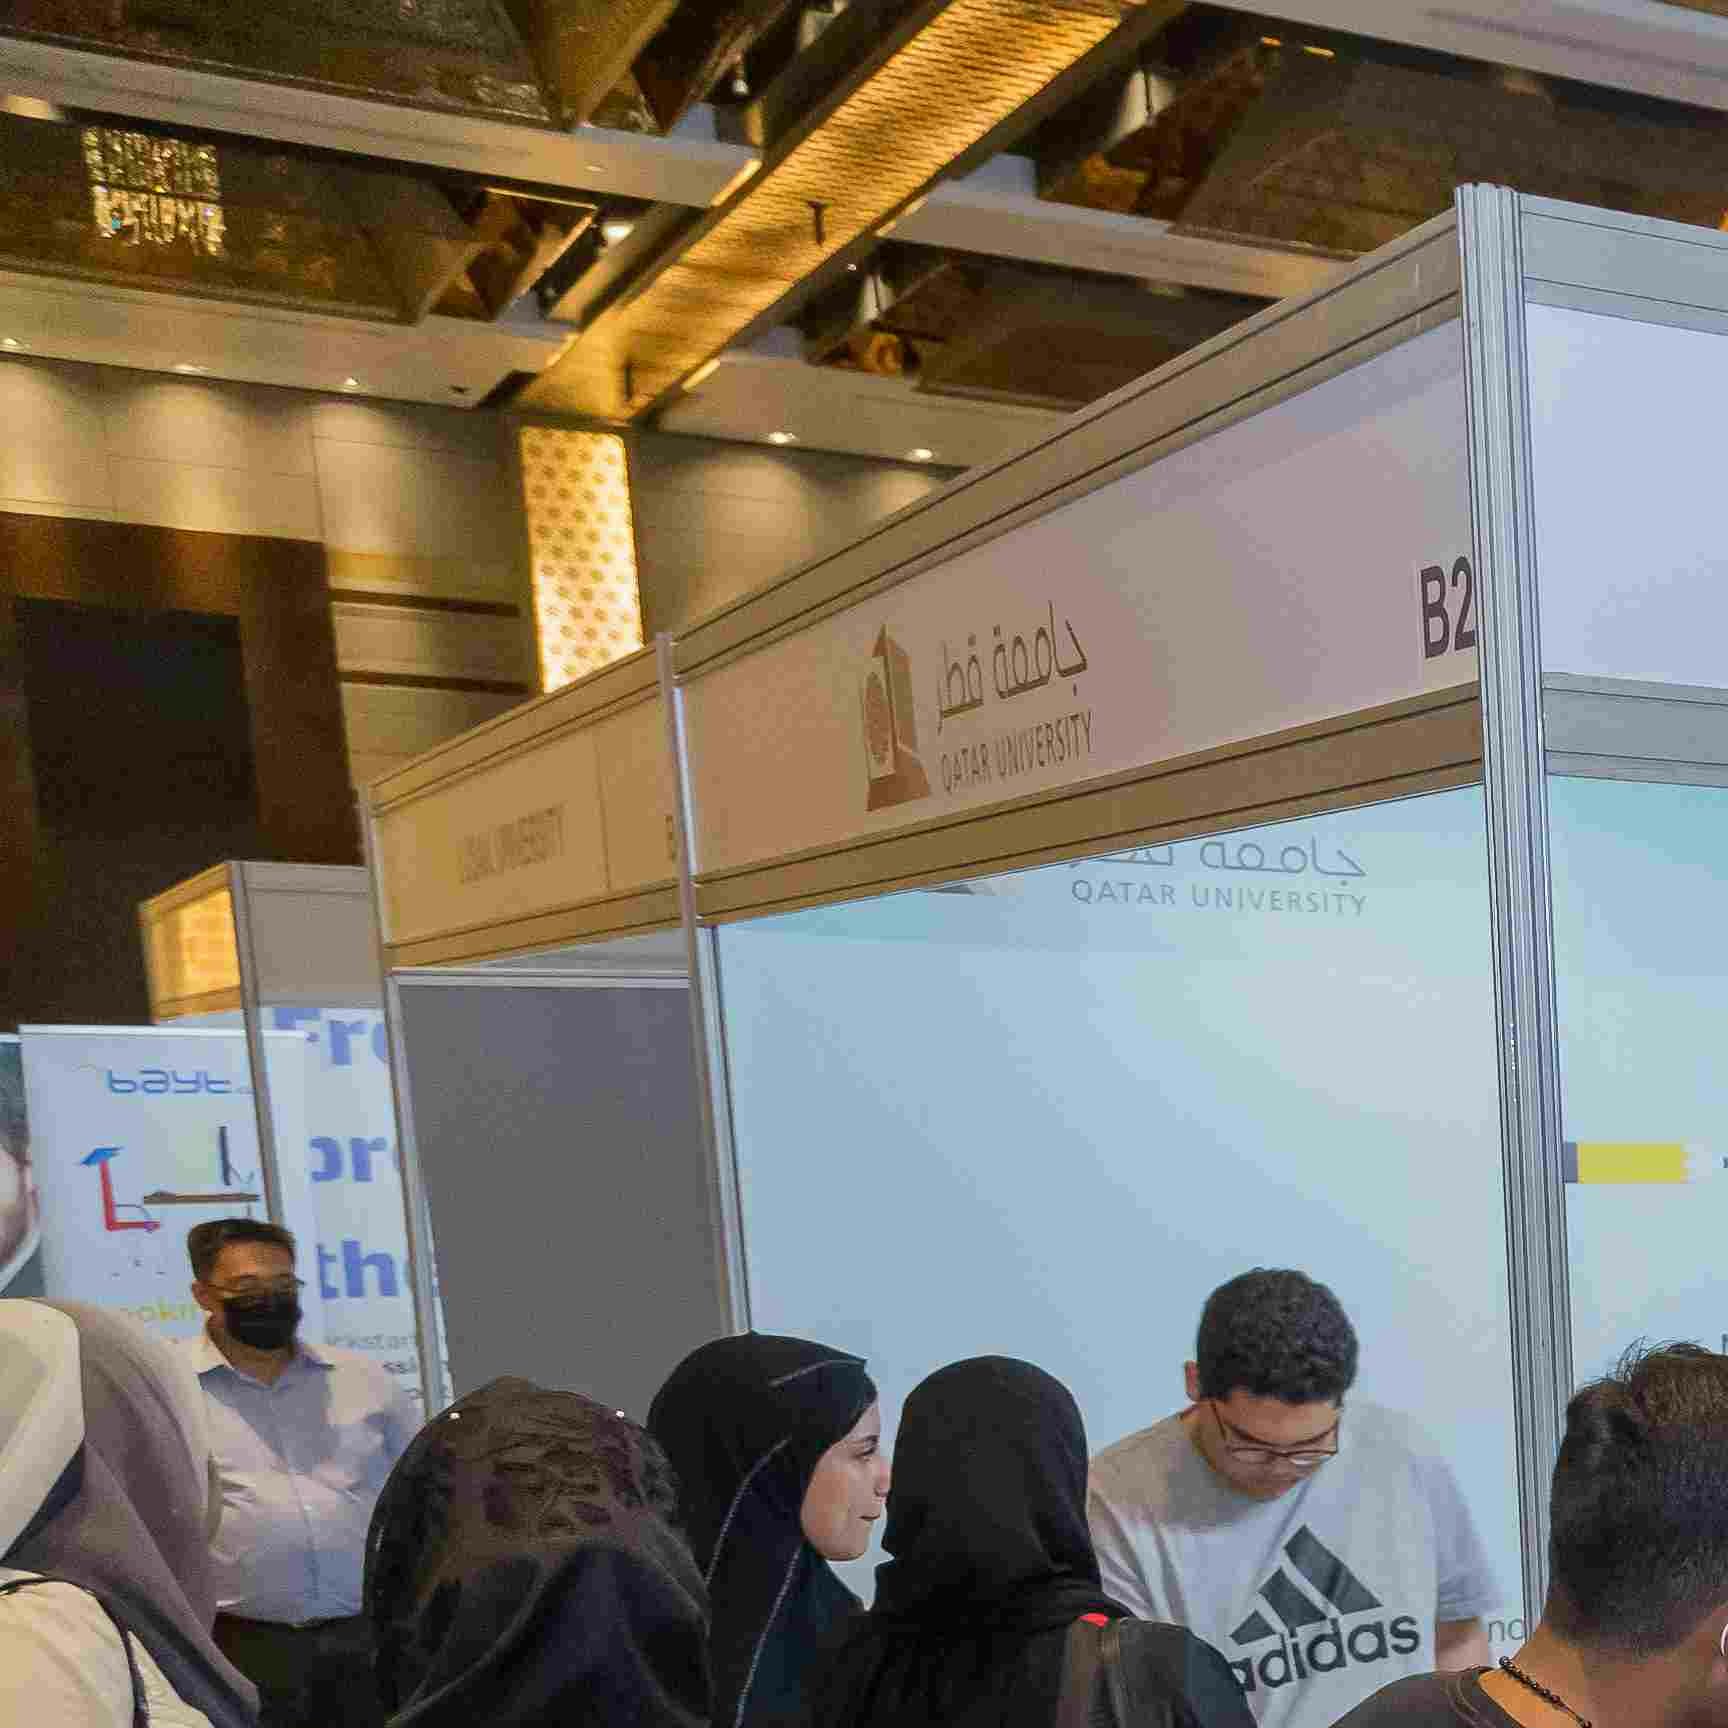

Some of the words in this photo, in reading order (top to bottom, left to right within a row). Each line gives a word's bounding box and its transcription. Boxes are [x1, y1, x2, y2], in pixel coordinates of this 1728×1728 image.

[993, 600, 1087, 699] جامعة
[1421, 556, 1476, 659] B2
[937, 632, 984, 736] قطر
[940, 742, 992, 794] QATAR
[999, 709, 1092, 777] UNIVERSITY
[1071, 879, 1176, 904] QATAR
[1191, 883, 1366, 916] UNIVERSITY
[1229, 1614, 1421, 1693] adidas
